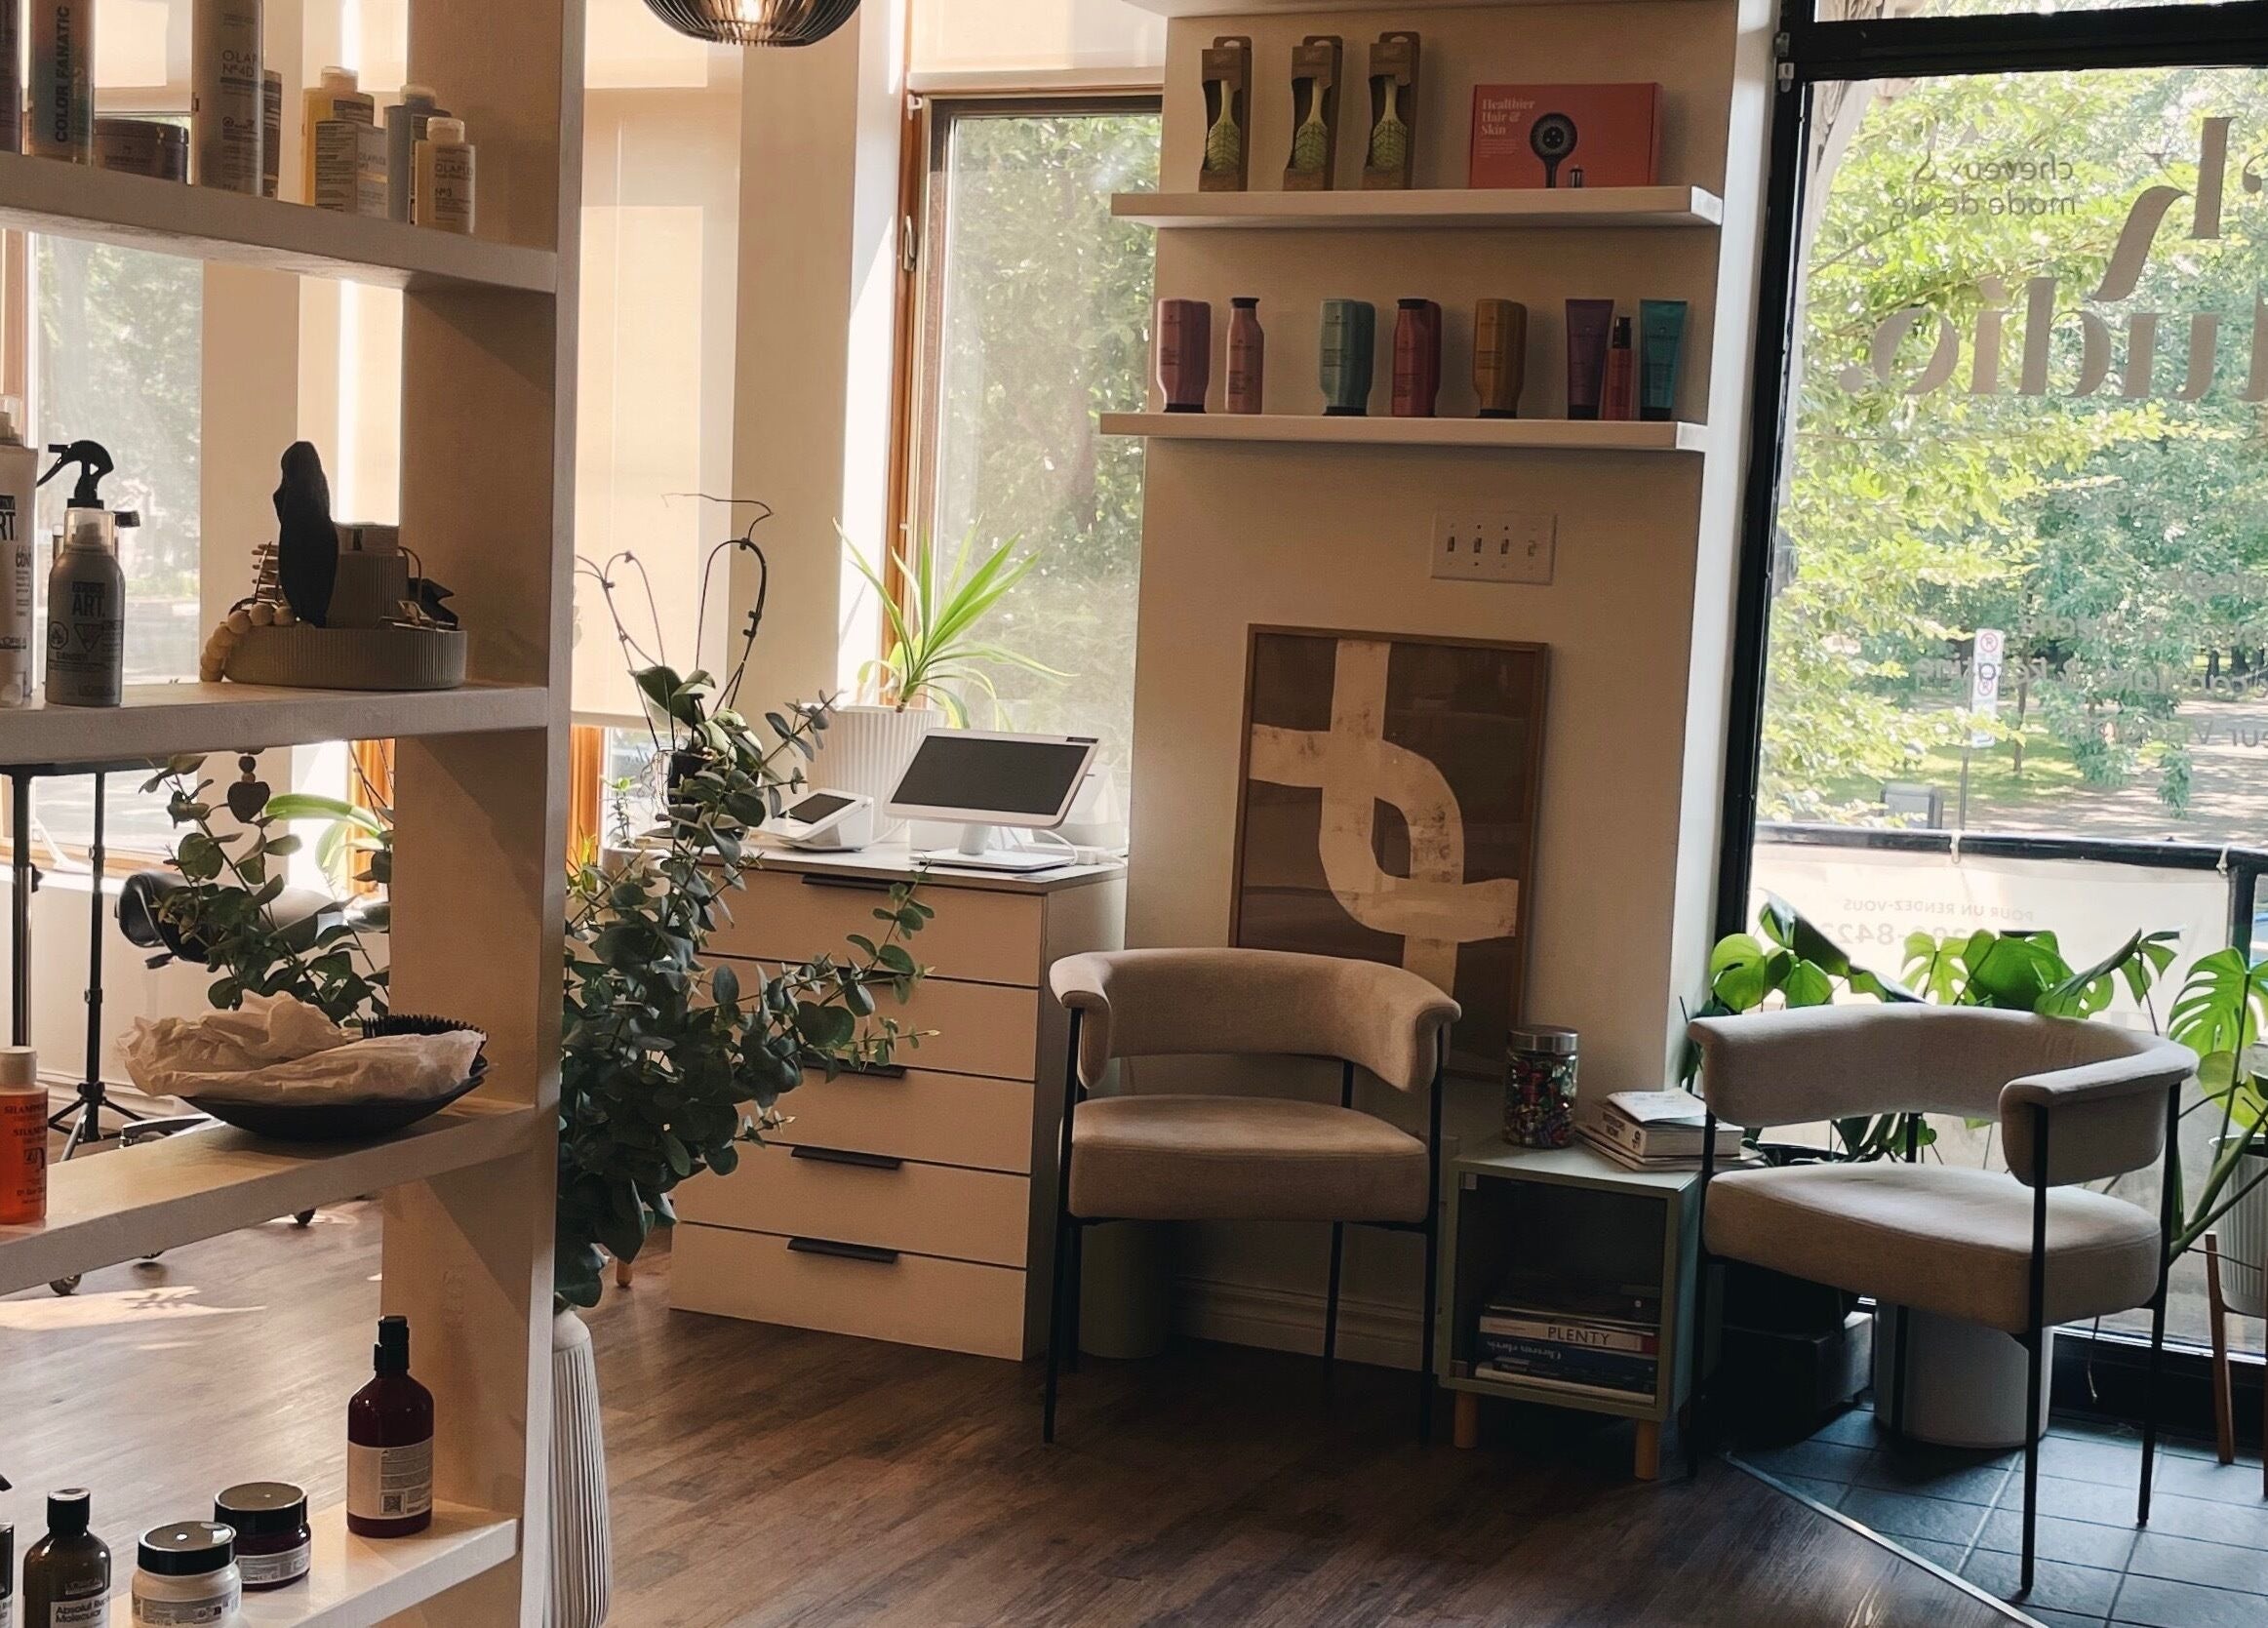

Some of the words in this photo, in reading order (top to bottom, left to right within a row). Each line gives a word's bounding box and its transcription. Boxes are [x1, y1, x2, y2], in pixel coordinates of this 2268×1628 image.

[55, 5, 71, 80] FANATIC
[1482, 98, 1535, 109] Healthier
[55, 86, 69, 143] COLOR
[1482, 111, 1507, 123] Hair
[1509, 111, 1521, 123] &
[1481, 124, 1506, 136] Skin
[1547, 1326, 1611, 1345] PLENTY
